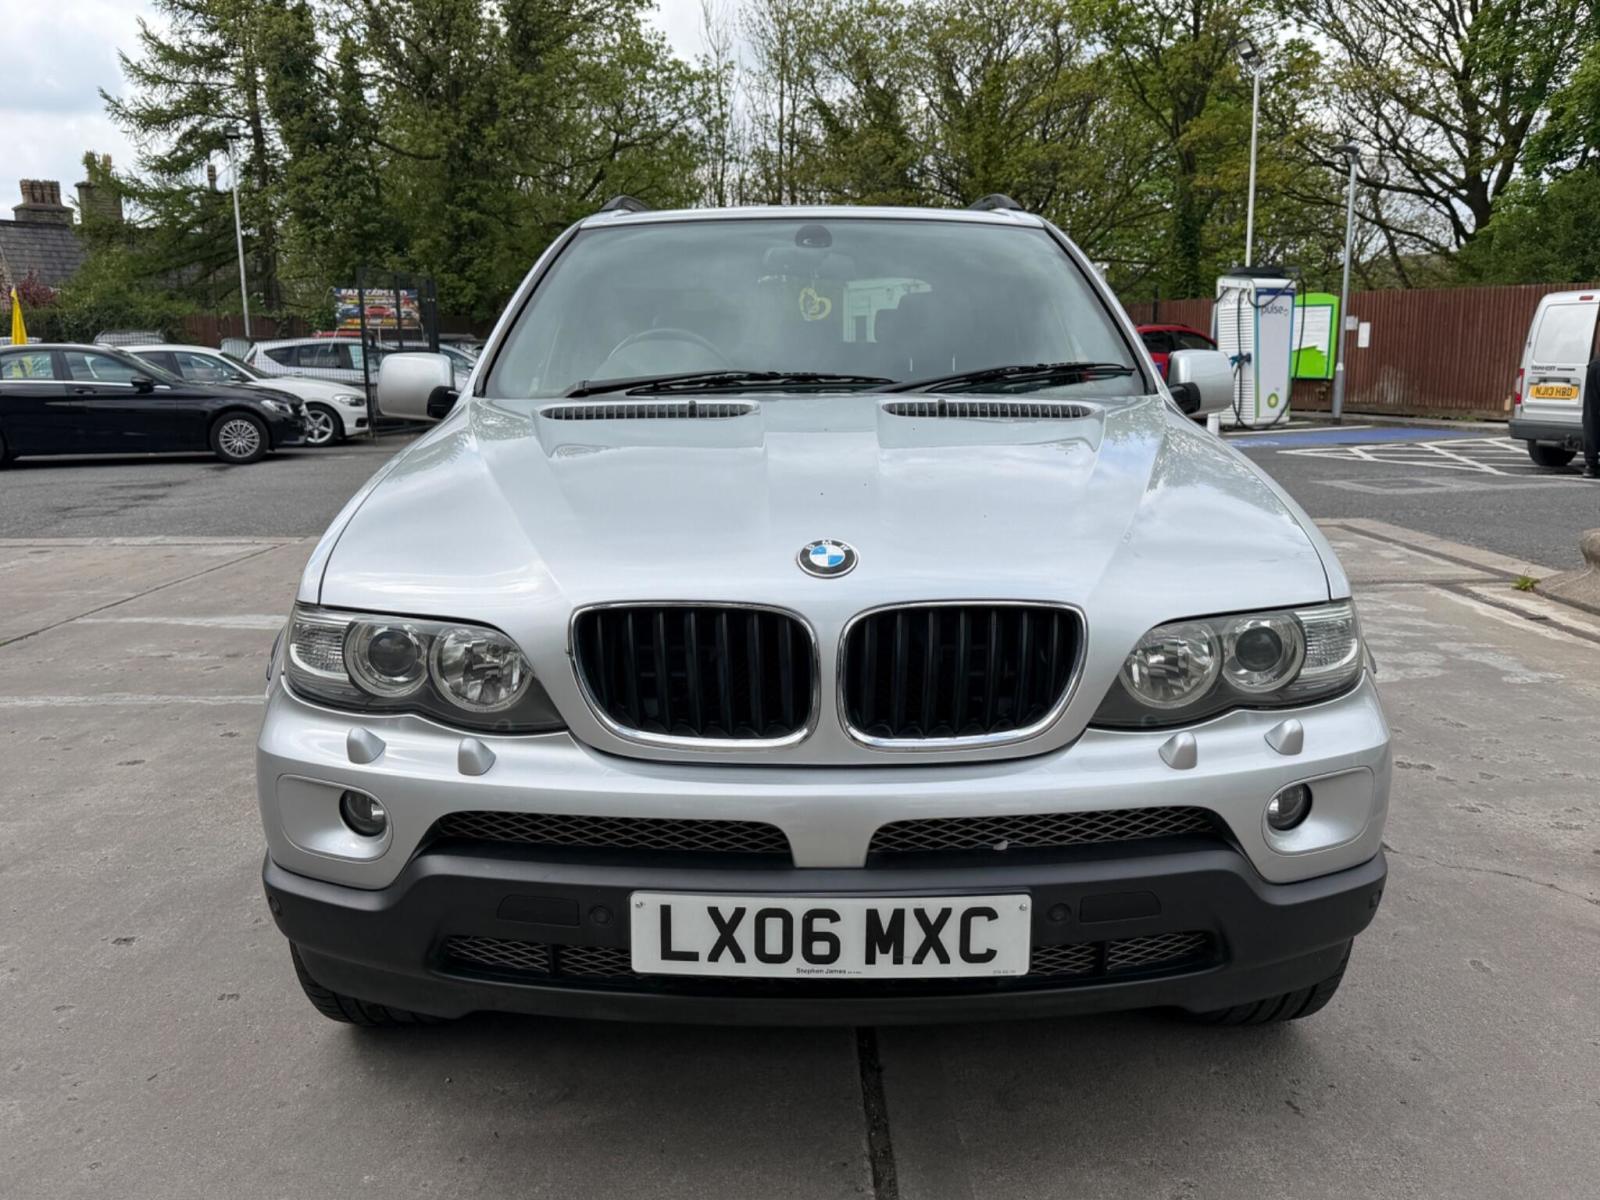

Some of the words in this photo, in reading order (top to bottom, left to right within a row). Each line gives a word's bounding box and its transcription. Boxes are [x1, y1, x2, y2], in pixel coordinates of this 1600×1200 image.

[390, 288, 408, 296] LD
[1261, 303, 1284, 316] pulse
[1535, 385, 1555, 396] NJ13
[660, 904, 841, 965] LX06
[865, 906, 999, 965] MXC
[796, 967, 824, 976] Stephen
